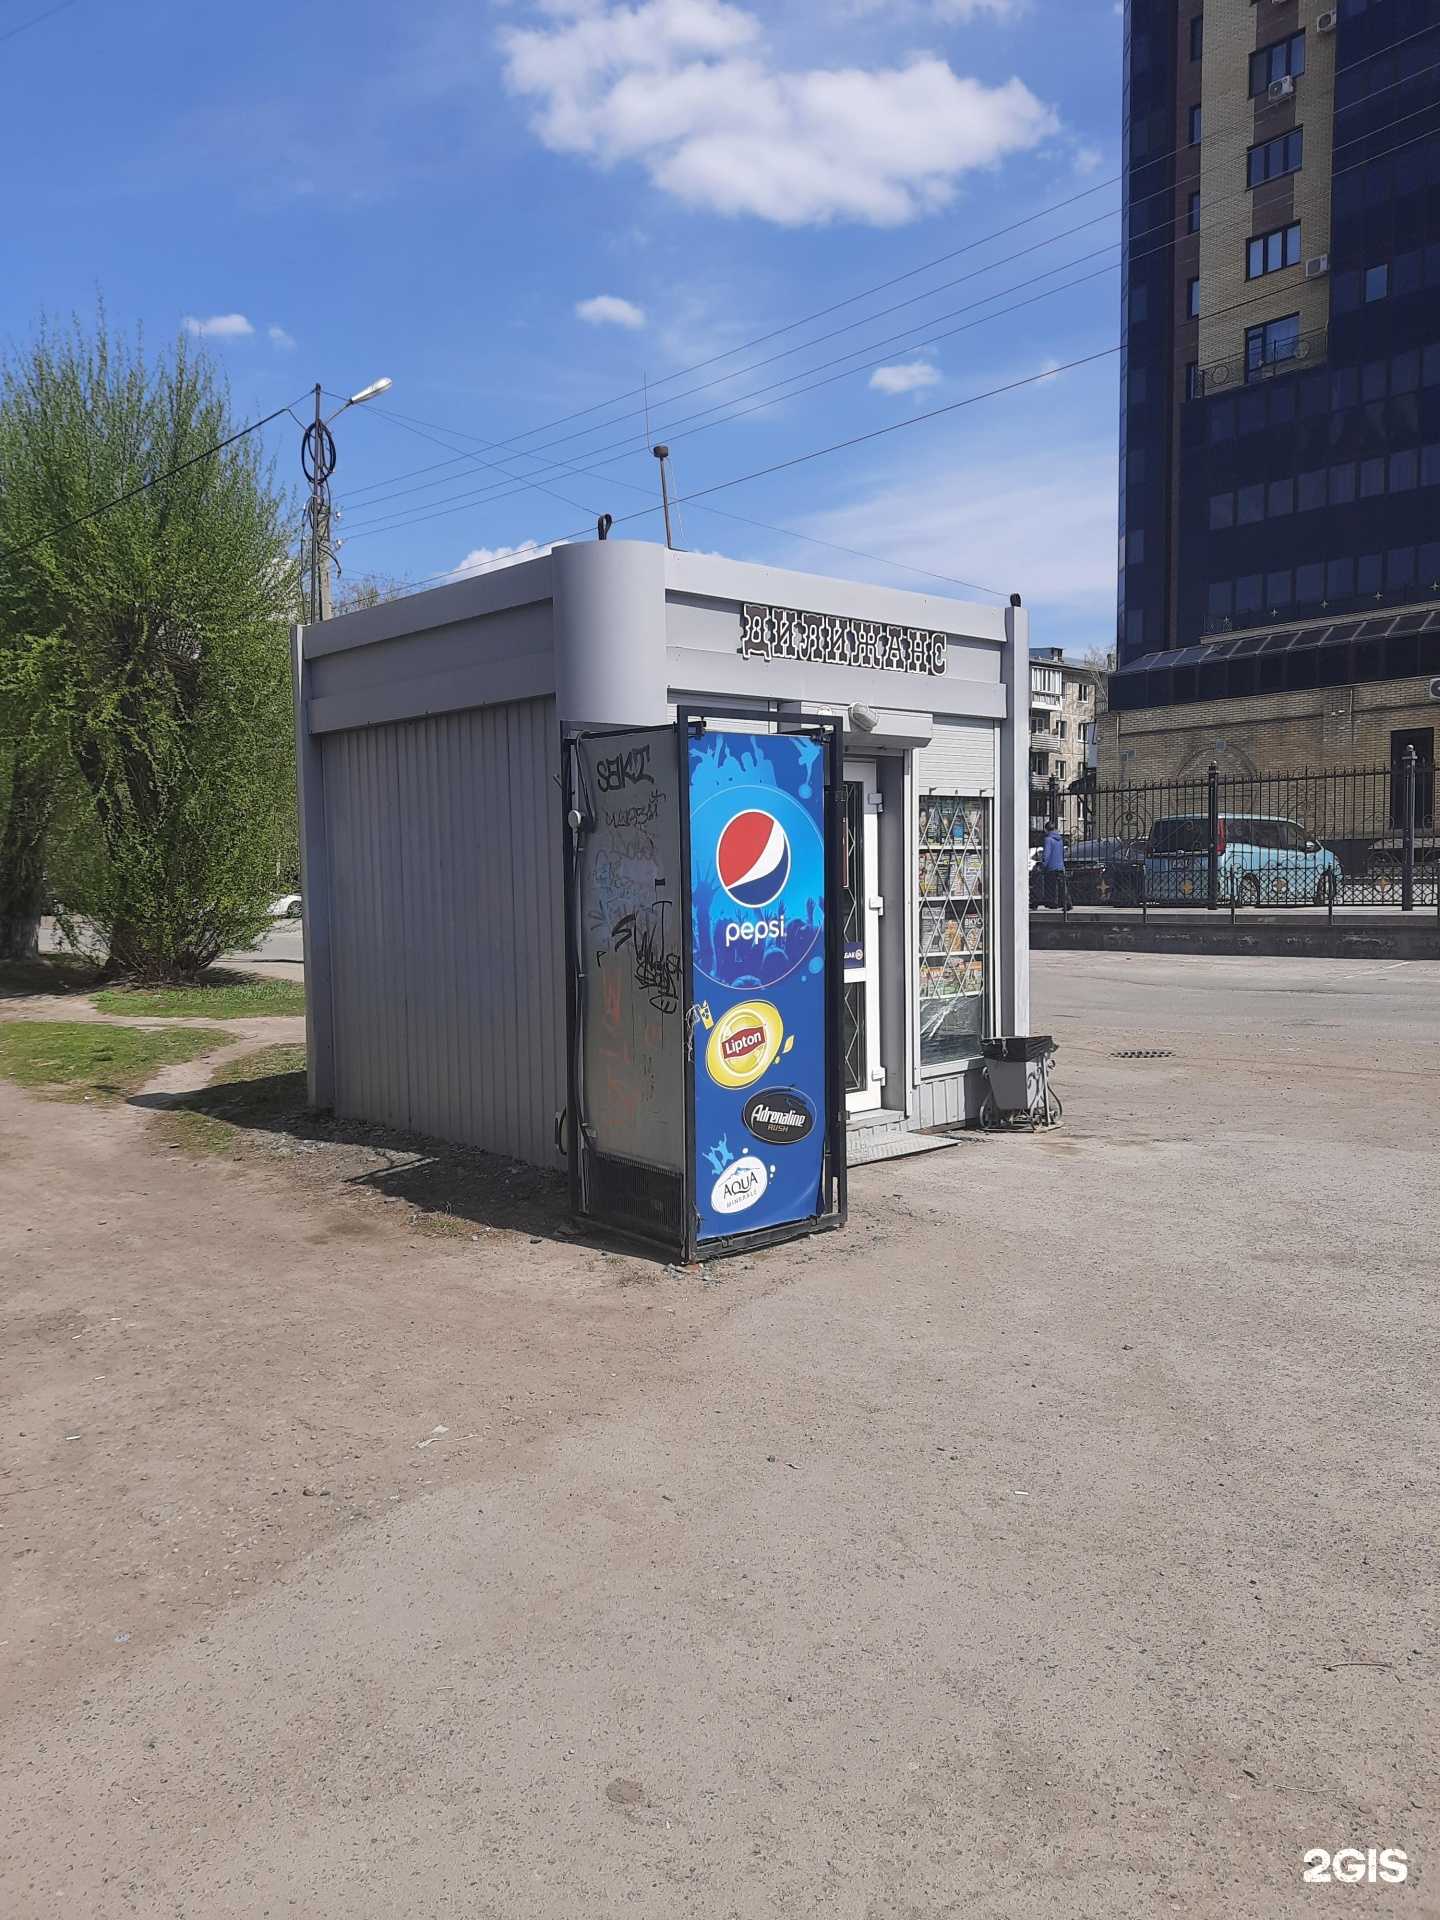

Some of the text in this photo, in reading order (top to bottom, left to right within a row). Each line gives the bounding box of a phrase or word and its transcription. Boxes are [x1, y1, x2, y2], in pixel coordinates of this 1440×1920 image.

[742, 603, 947, 677] ДИЛИЖАНС
[725, 914, 785, 947] pepsi
[725, 1032, 762, 1054] Lipton
[751, 1103, 806, 1128] Adrenaline
[767, 1122, 789, 1133] RUSH
[723, 1171, 758, 1199] AQUA
